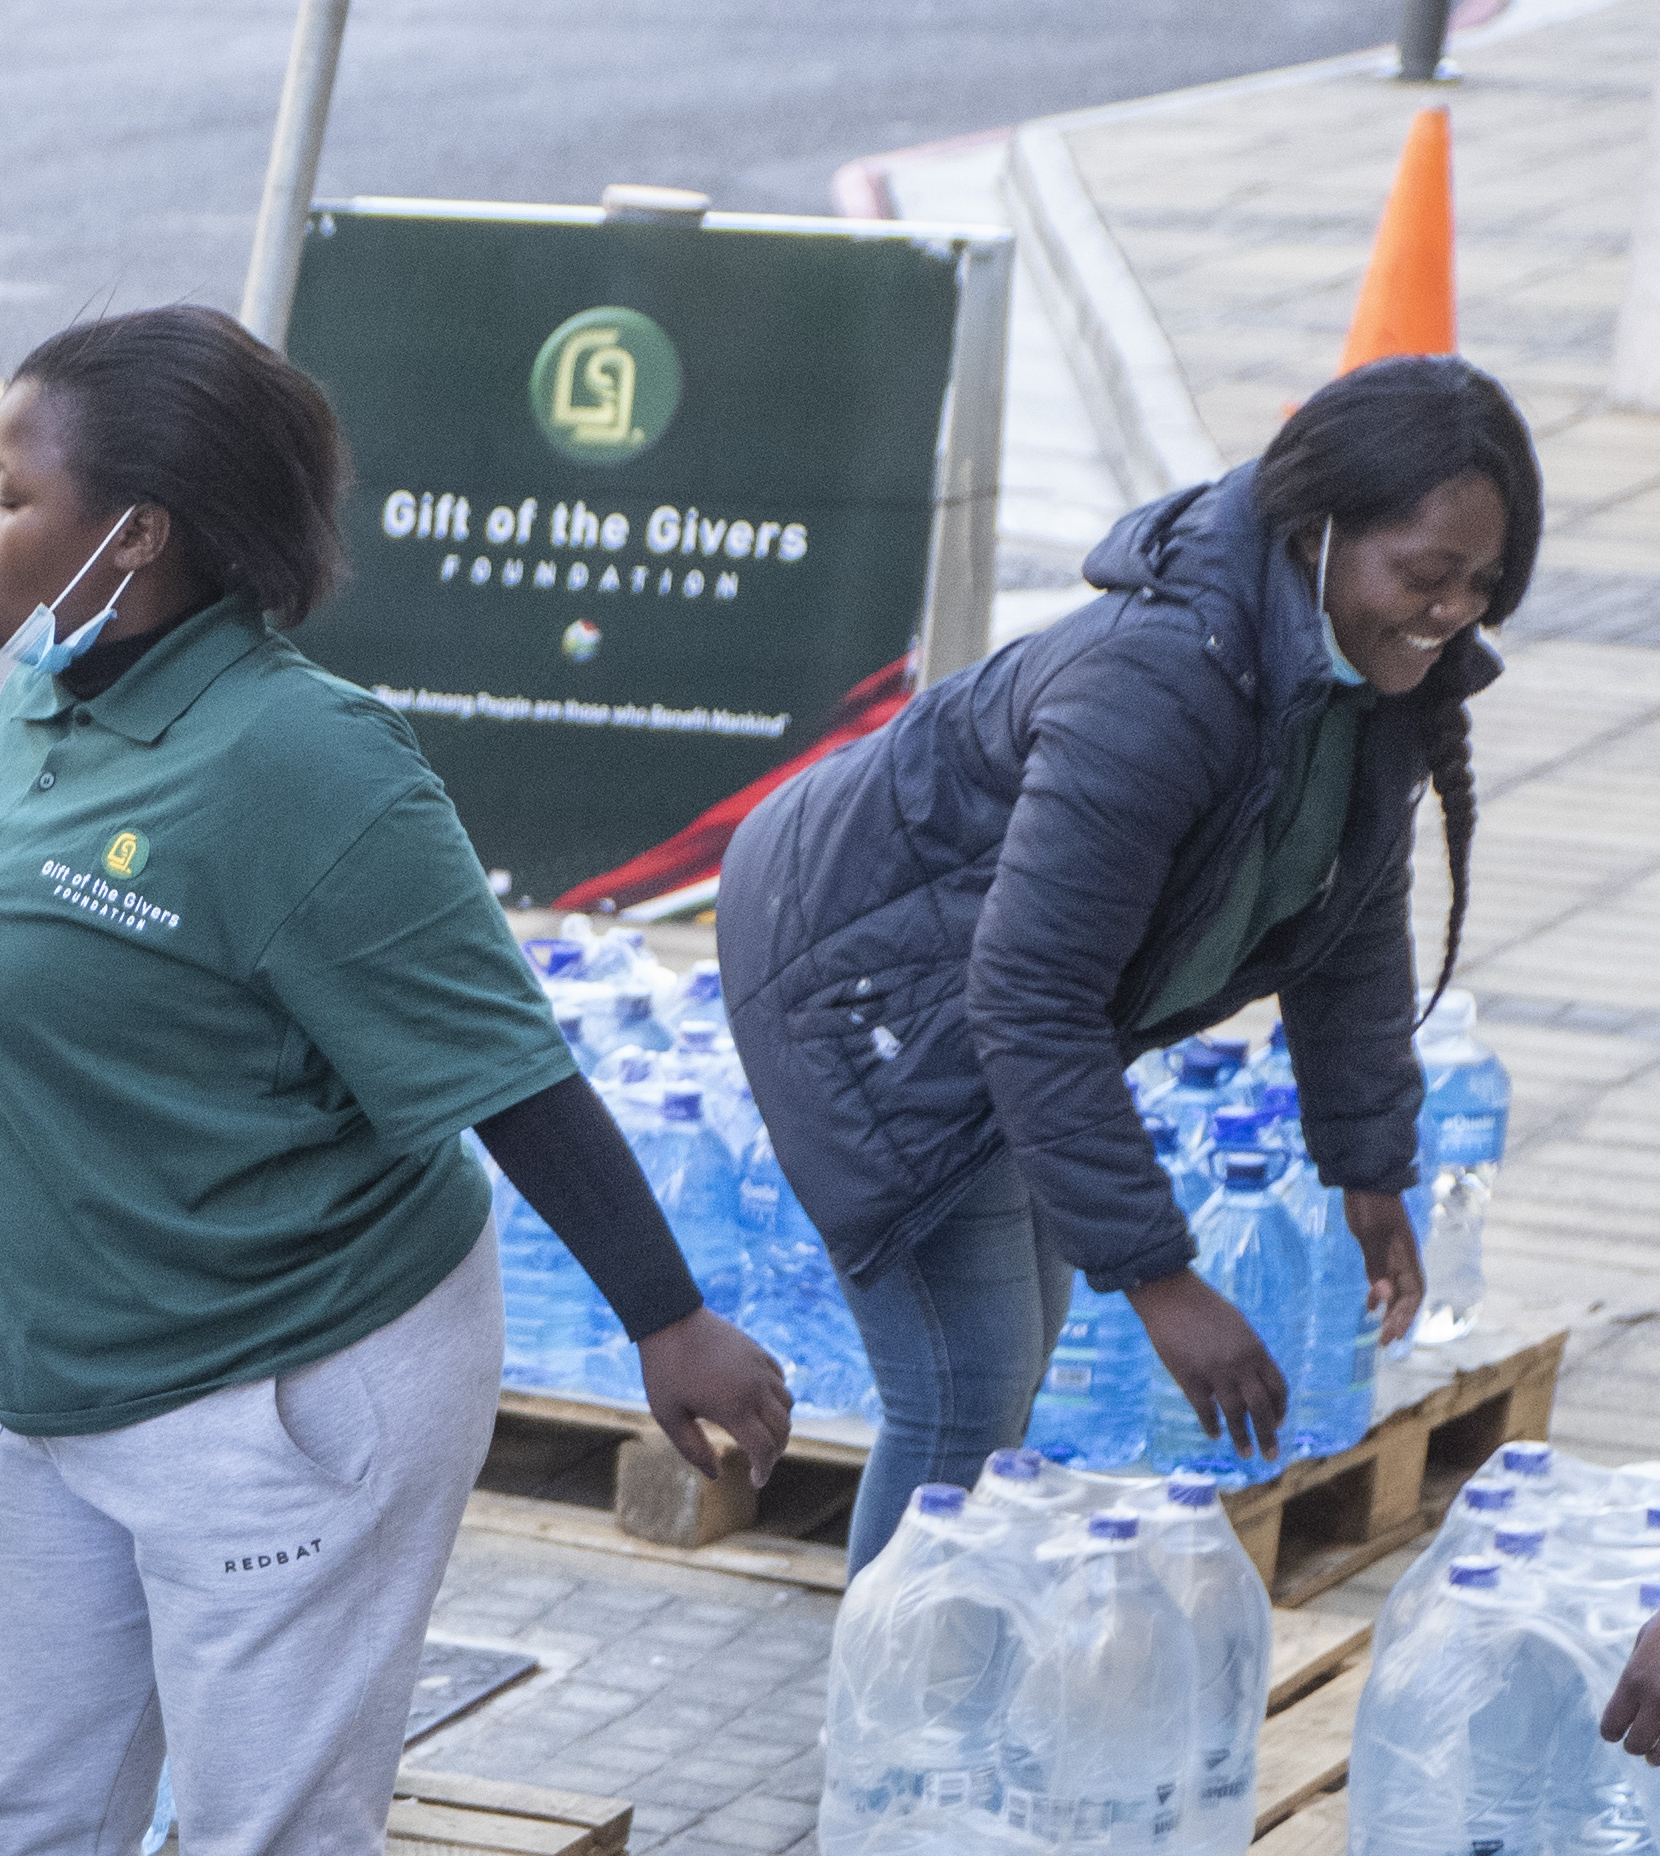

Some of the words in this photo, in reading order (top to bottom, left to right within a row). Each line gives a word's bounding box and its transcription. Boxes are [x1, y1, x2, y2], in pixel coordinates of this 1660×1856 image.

[382, 489, 470, 540] Gift
[485, 497, 538, 545] of
[550, 500, 630, 551] the
[646, 504, 808, 563] Givers
[440, 553, 739, 600] FOUNDATION
[41, 859, 71, 882] Gift
[71, 872, 92, 890] of
[92, 878, 119, 902] the
[124, 891, 181, 928] Givers
[53, 884, 147, 931] FOUNDATION
[224, 1537, 321, 1574] REDBAT
